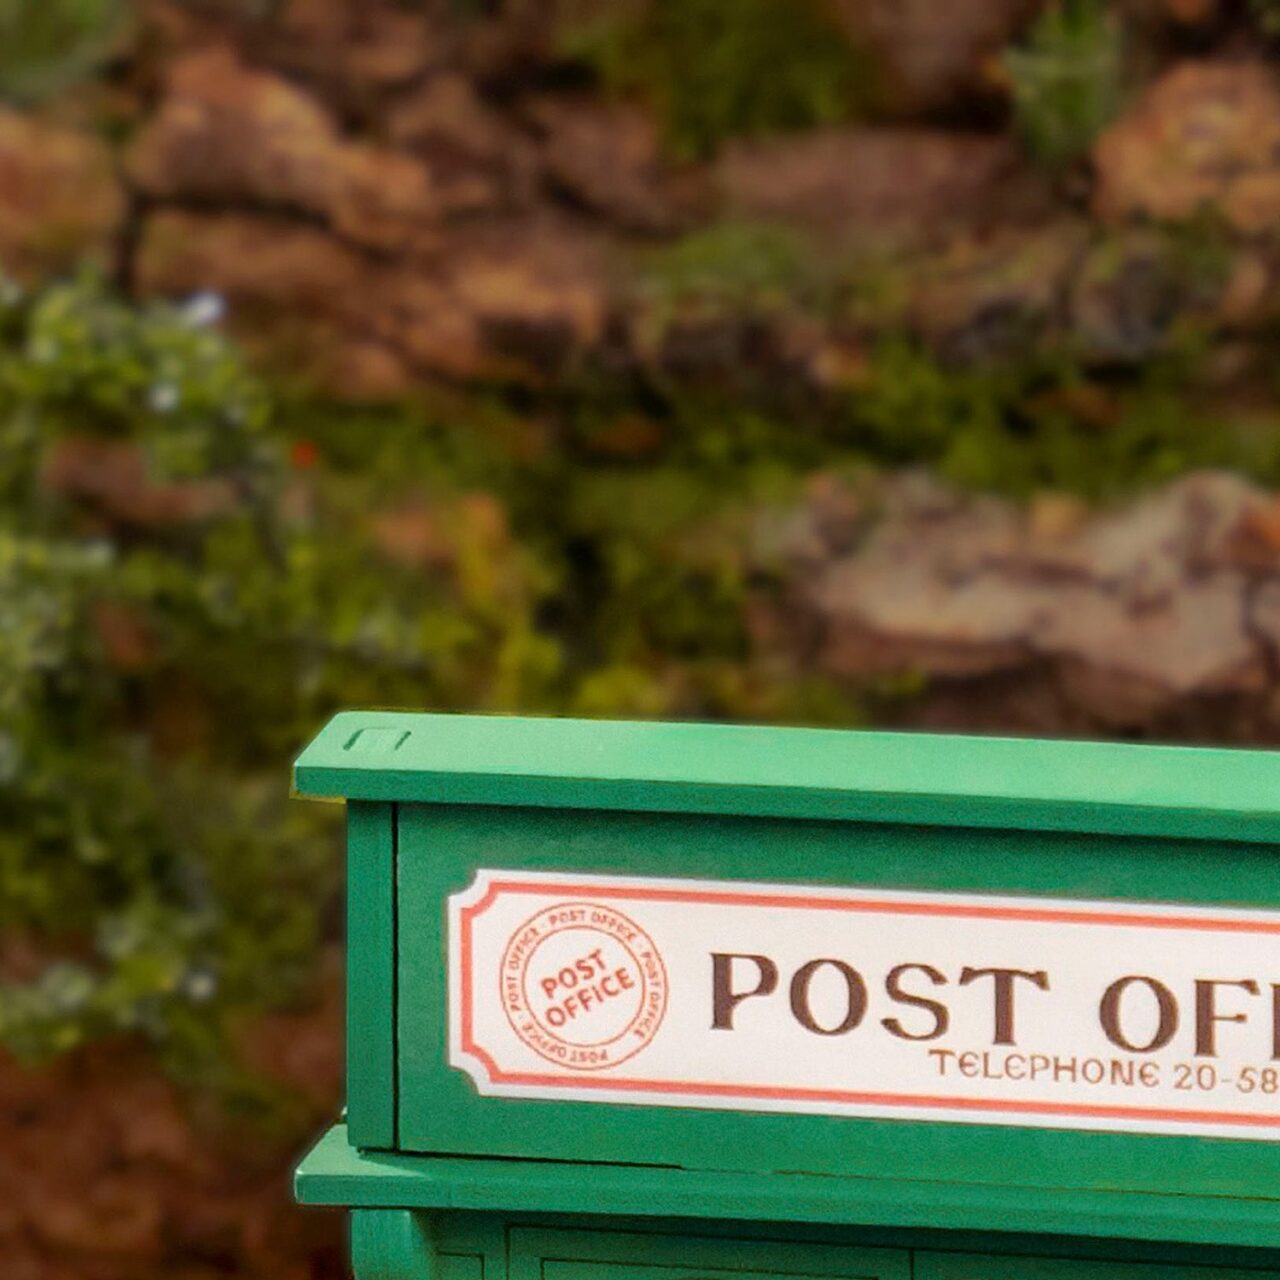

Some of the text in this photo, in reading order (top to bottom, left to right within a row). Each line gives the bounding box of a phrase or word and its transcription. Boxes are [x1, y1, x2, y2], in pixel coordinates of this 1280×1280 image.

[540, 948, 606, 999] POST
[545, 967, 634, 1027] OFFICE
[709, 952, 1051, 1047] POST
[929, 1048, 1280, 1095] TELEPHONE 20-58
